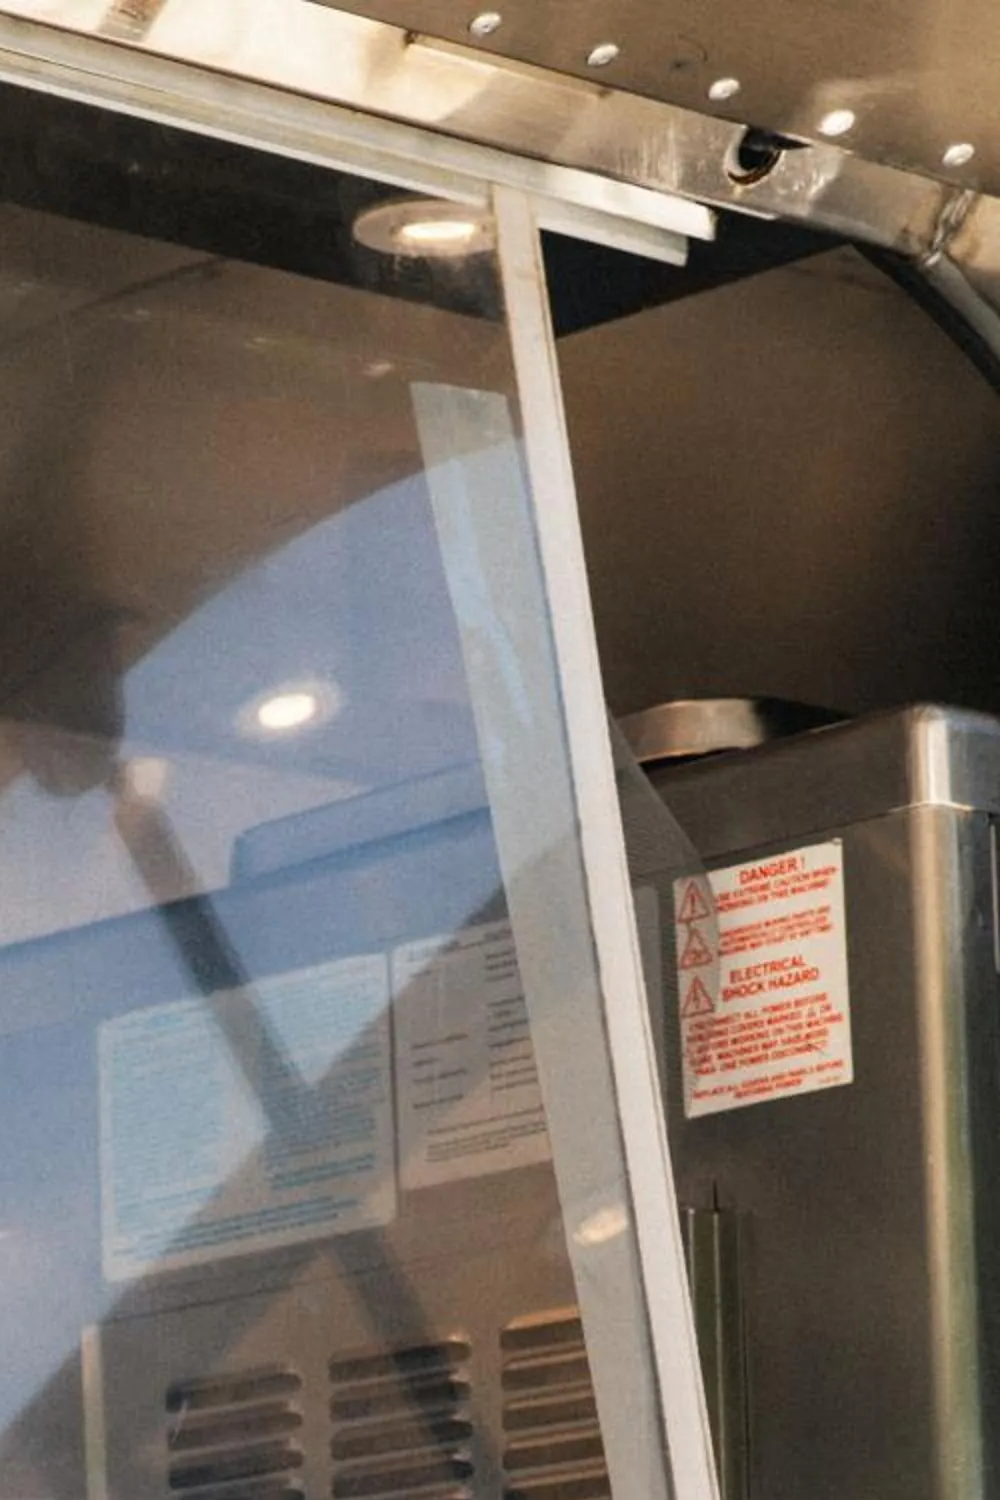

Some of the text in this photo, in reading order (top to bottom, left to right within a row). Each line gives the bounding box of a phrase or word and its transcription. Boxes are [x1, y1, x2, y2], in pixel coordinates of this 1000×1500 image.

[739, 857, 797, 883] DANGER
[729, 955, 804, 982] ELECTRICAL
[722, 967, 819, 1001] SHOCK HAZARD
